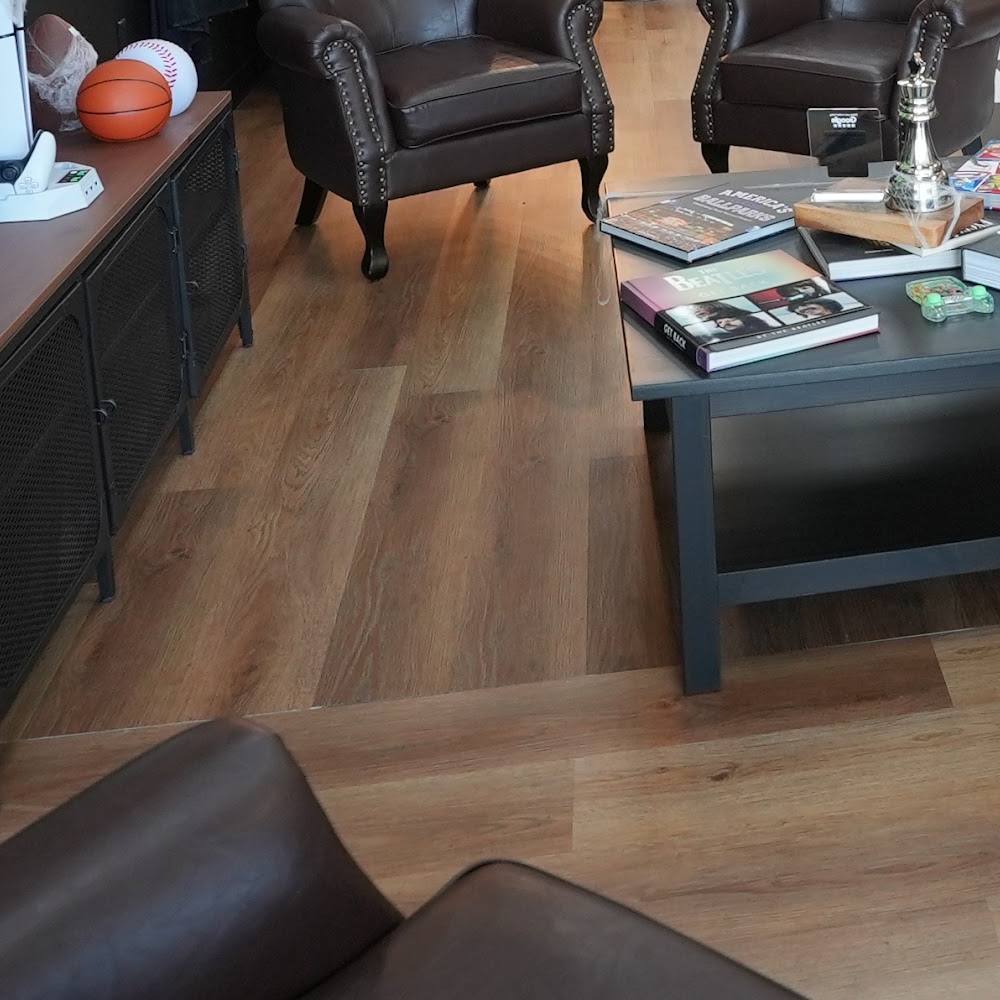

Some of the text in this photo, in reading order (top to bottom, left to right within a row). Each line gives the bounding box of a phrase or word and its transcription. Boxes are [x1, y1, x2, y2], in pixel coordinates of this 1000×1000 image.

[692, 194, 776, 222] BALLPARKS
[718, 189, 794, 214] AMERICA'S
[663, 323, 687, 350] GET BACK
